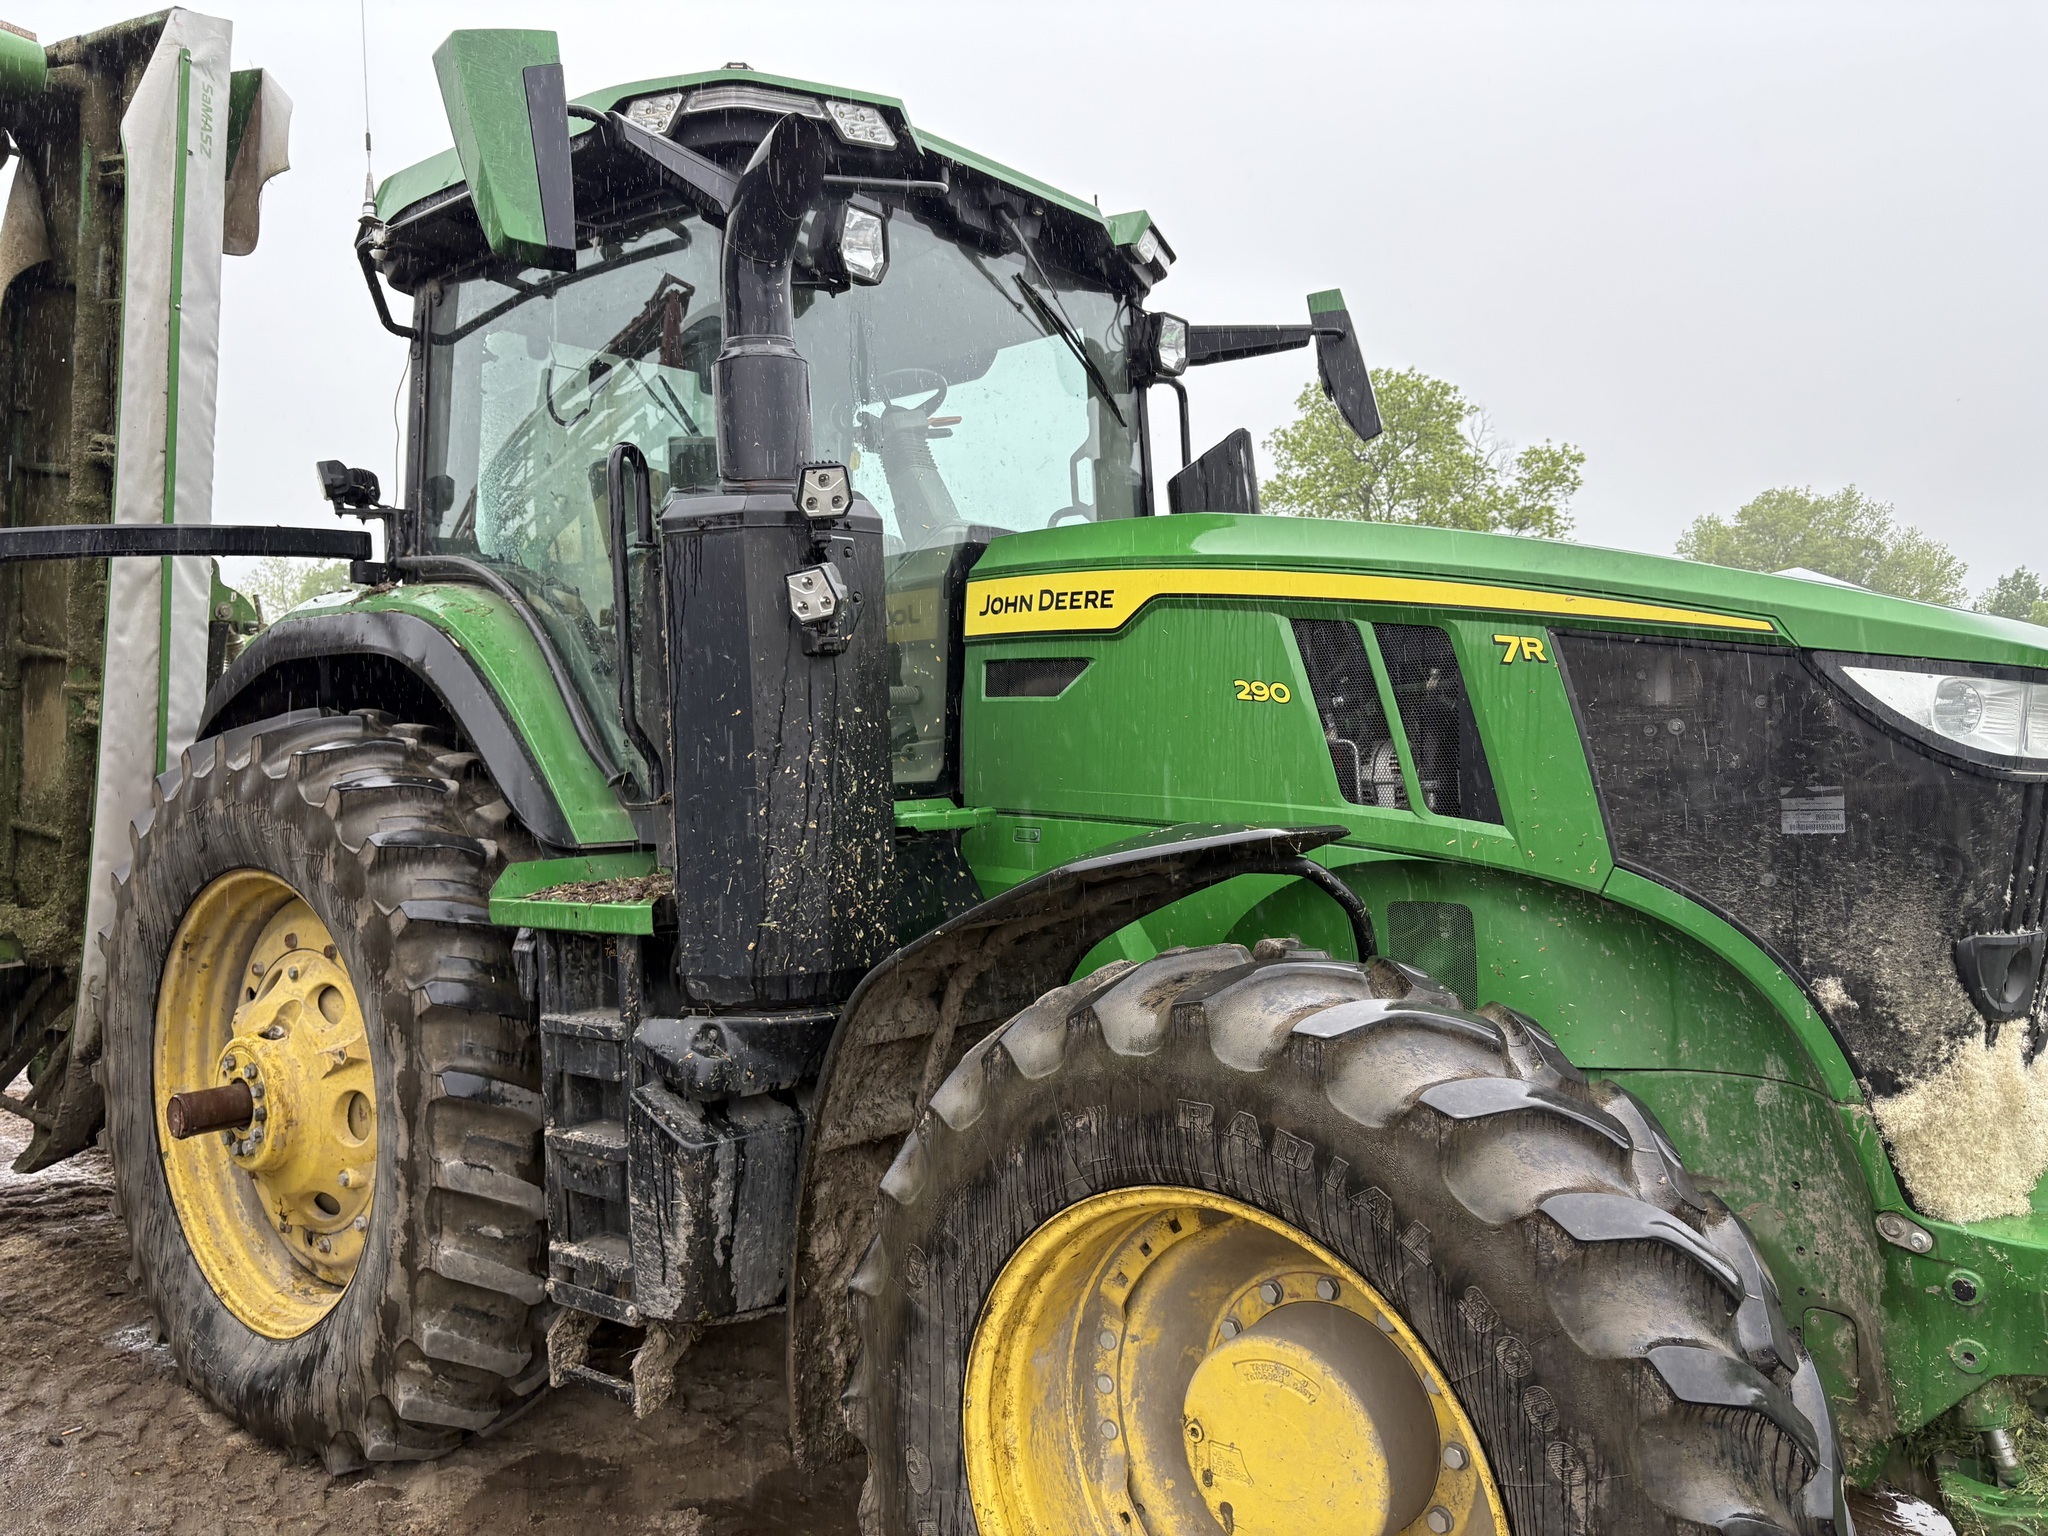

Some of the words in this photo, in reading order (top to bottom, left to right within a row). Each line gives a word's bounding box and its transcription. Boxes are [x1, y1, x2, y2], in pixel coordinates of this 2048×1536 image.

[979, 594, 1034, 617] JOHN
[1038, 589, 1115, 612] DEERE
[1491, 634, 1549, 666] 7R
[1233, 679, 1291, 704] 290
[1176, 1098, 1434, 1269] RADIAL
